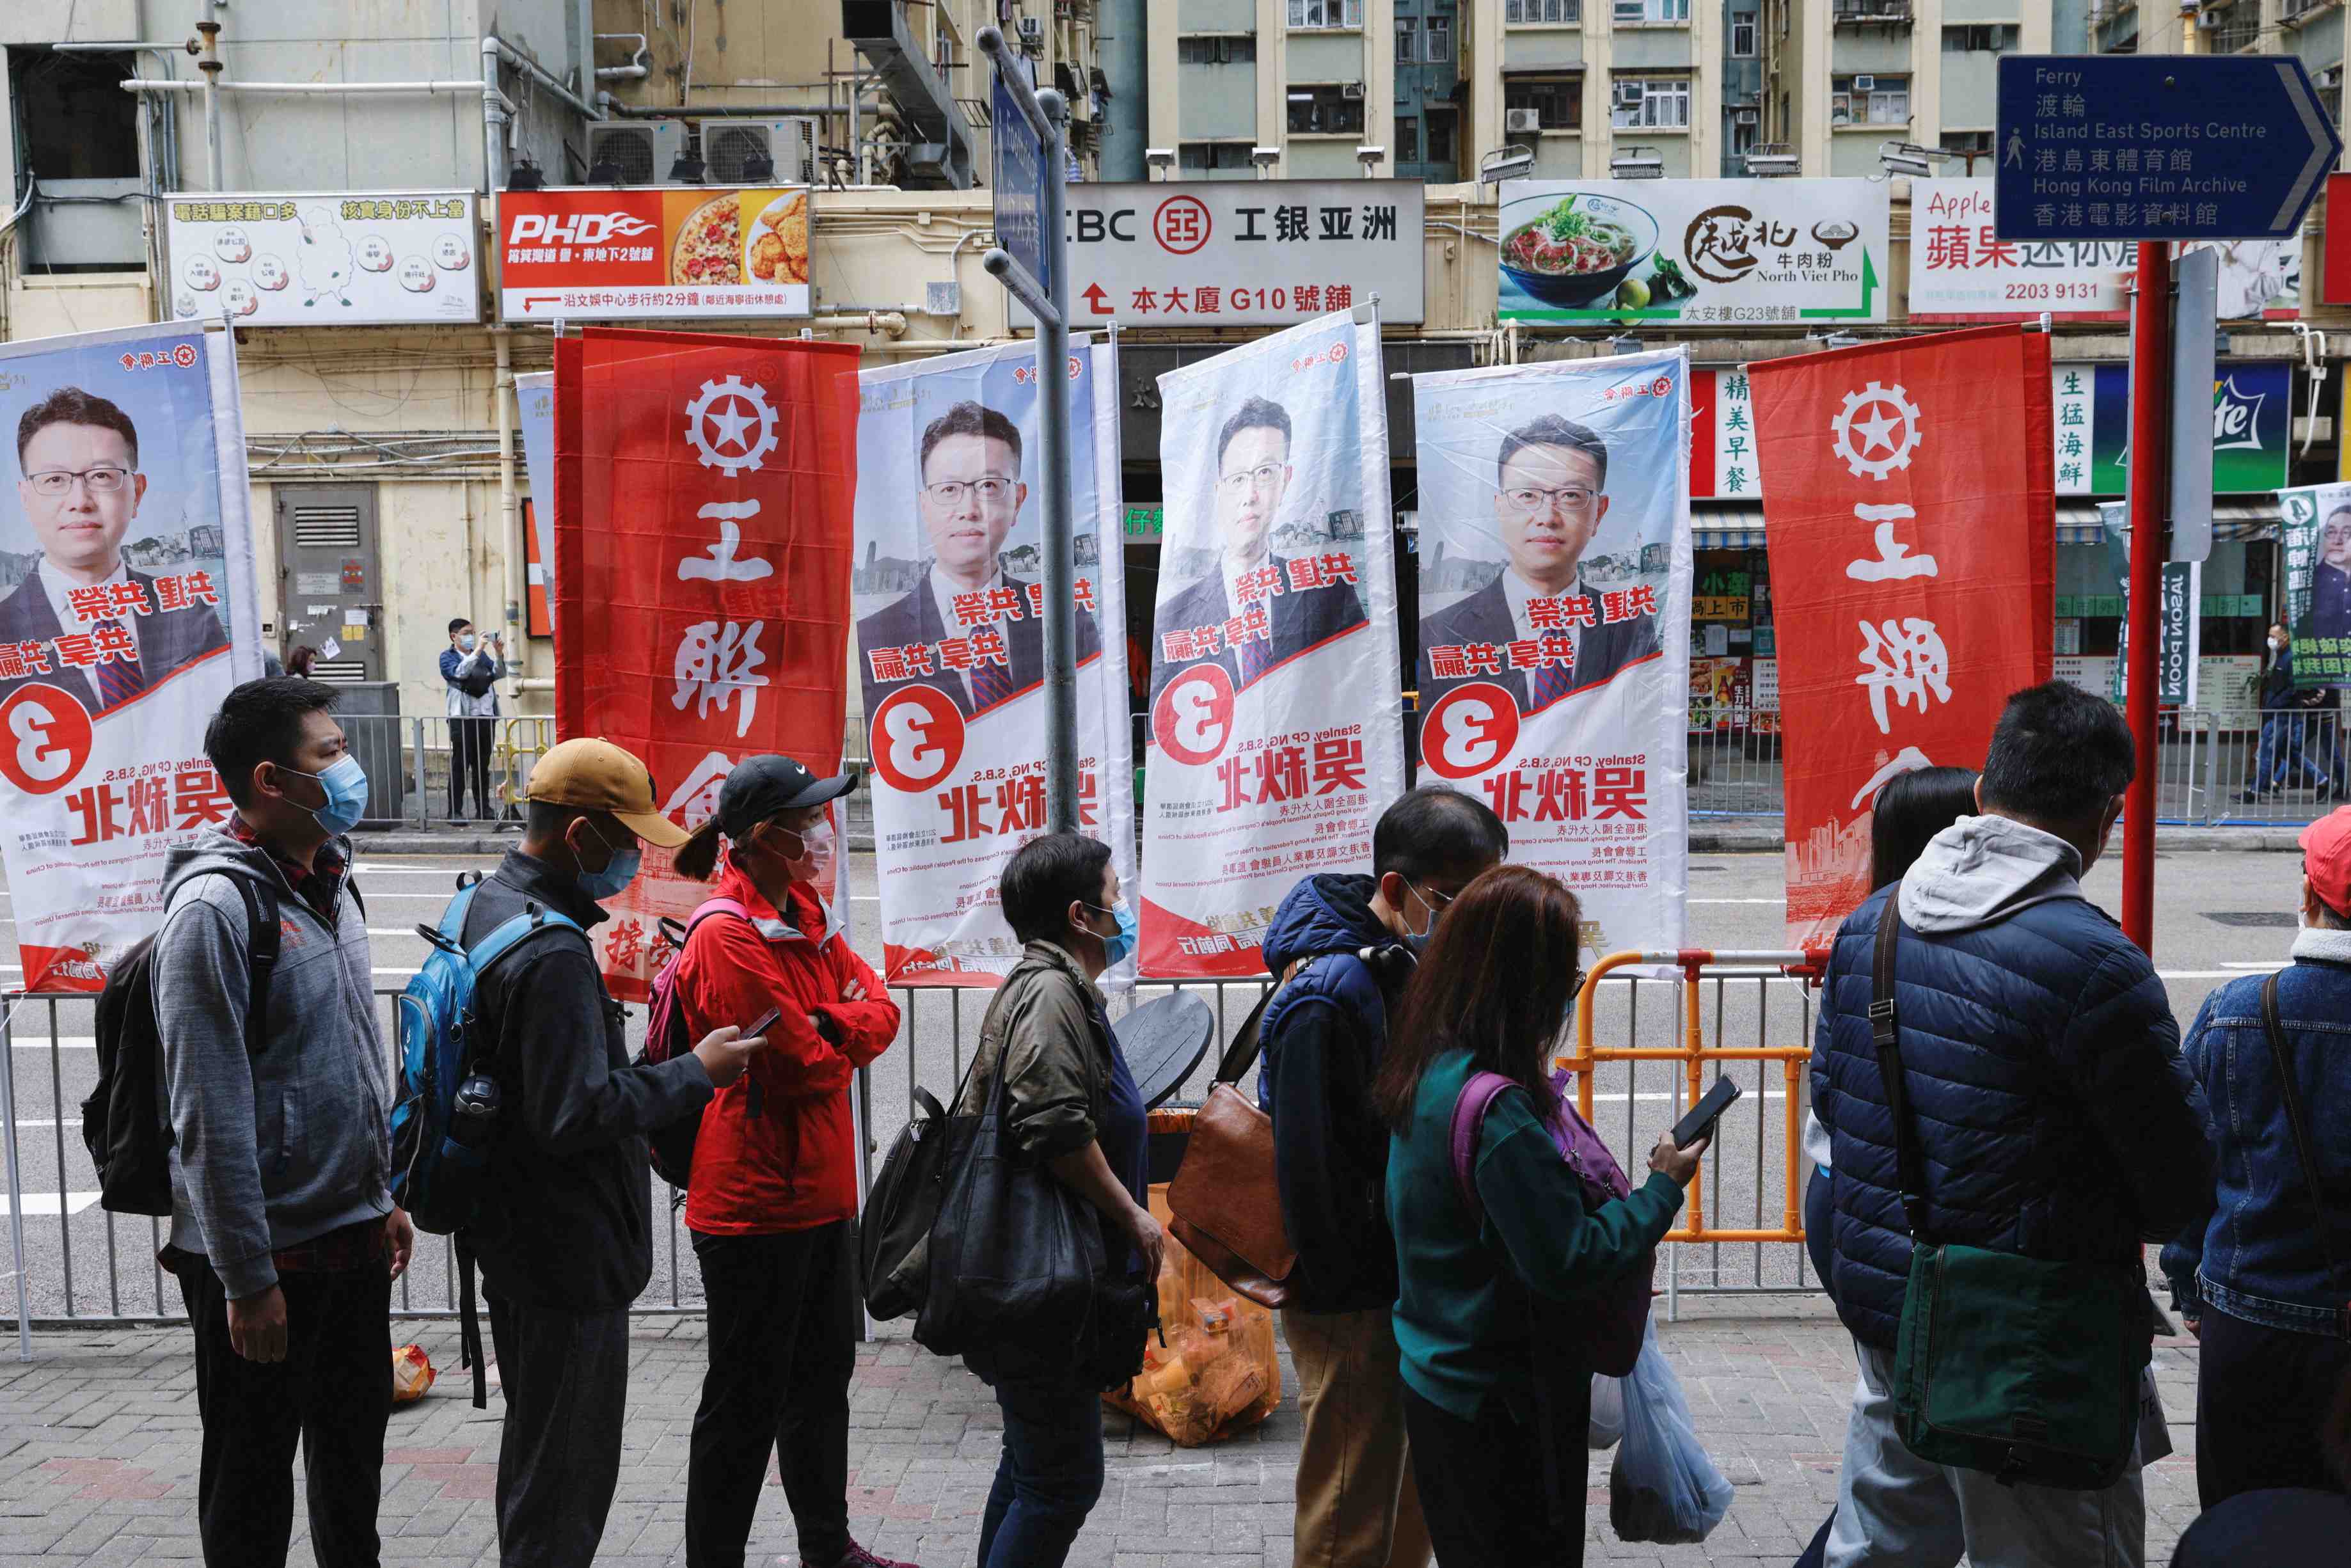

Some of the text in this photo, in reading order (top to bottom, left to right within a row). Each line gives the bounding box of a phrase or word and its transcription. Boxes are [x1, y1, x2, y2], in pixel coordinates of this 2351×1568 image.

[2036, 68, 2082, 88] Ferry
[2036, 93, 2086, 118] 渡輪
[2035, 123, 2267, 141] Island East Sports Centre
[2035, 148, 2192, 172] 港島東體育館
[2034, 177, 2247, 196] Hong Kong Film Archive
[175, 200, 464, 222] 電話騙案藉口多 核實身份不上當
[1928, 191, 1991, 219] Apple
[2033, 203, 2218, 226] 香港電影資料館
[509, 214, 615, 244] PHD
[1234, 205, 1397, 242] 工银亚洲
[1686, 206, 1796, 283] 越北
[1778, 253, 1833, 269] 牛肉粉
[1757, 271, 1858, 283] North Viet Pho
[564, 292, 700, 307] 沿文娛中心步行約2分鐘
[1132, 285, 1352, 314] 本大廈 G10 號舖
[2006, 283, 2049, 299] 2203
[2055, 283, 2098, 299] 9131
[1686, 306, 1796, 321] 太安樓G23號舖
[1723, 376, 1750, 492] 精美早餐
[2057, 371, 2086, 487] 生猛海鮮
